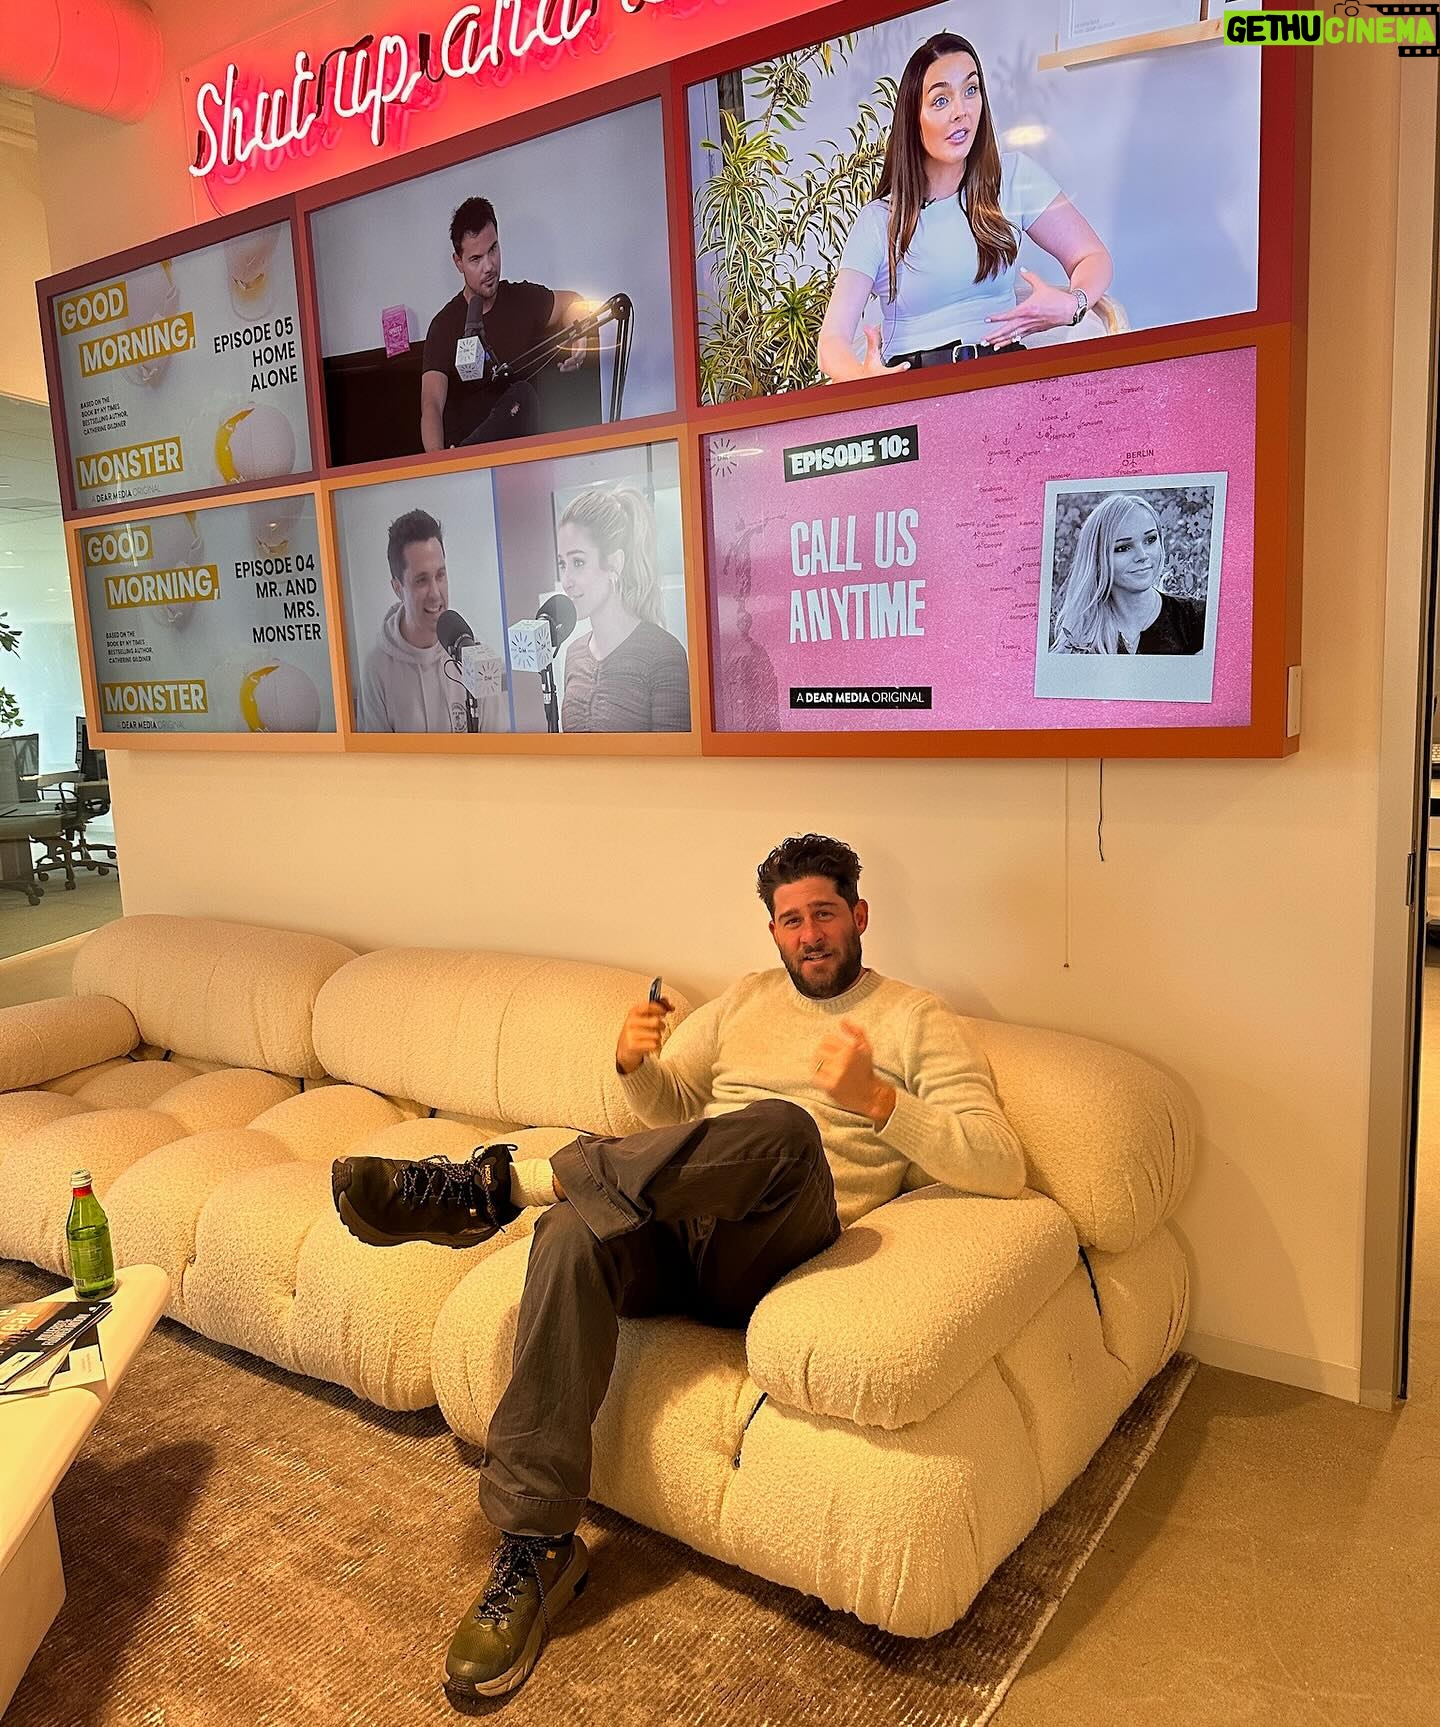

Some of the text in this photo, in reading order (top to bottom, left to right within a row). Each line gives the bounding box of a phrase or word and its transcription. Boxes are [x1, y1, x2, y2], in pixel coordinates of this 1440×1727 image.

[189, 51, 317, 177] Shut
[334, 35, 422, 147] up
[61, 287, 125, 330] GOOD
[82, 318, 196, 374] MORNING,
[213, 316, 294, 354] EPISODE 05
[252, 341, 296, 368] HOME
[250, 365, 298, 393] ALONE
[79, 441, 180, 488] MONSTER
[790, 434, 911, 476] EPISODE 10:
[1126, 449, 1154, 459] BERLIN
[96, 492, 112, 503] DEAR
[111, 489, 133, 500] MEDIA
[87, 530, 149, 562] GOOD
[790, 507, 920, 577] CALL US
[235, 554, 315, 579] EPISODE 04
[107, 568, 220, 605] MORNING,
[256, 577, 318, 599] MR. AND
[283, 600, 320, 619] MRS.
[789, 580, 926, 644] ANYTIME
[252, 623, 322, 644] MONSTER
[104, 683, 205, 713] MONSTER
[796, 692, 925, 703] A DEAR MEDIA ORIGINAL
[122, 720, 136, 728] DEAR
[138, 720, 158, 728] MEDIA
